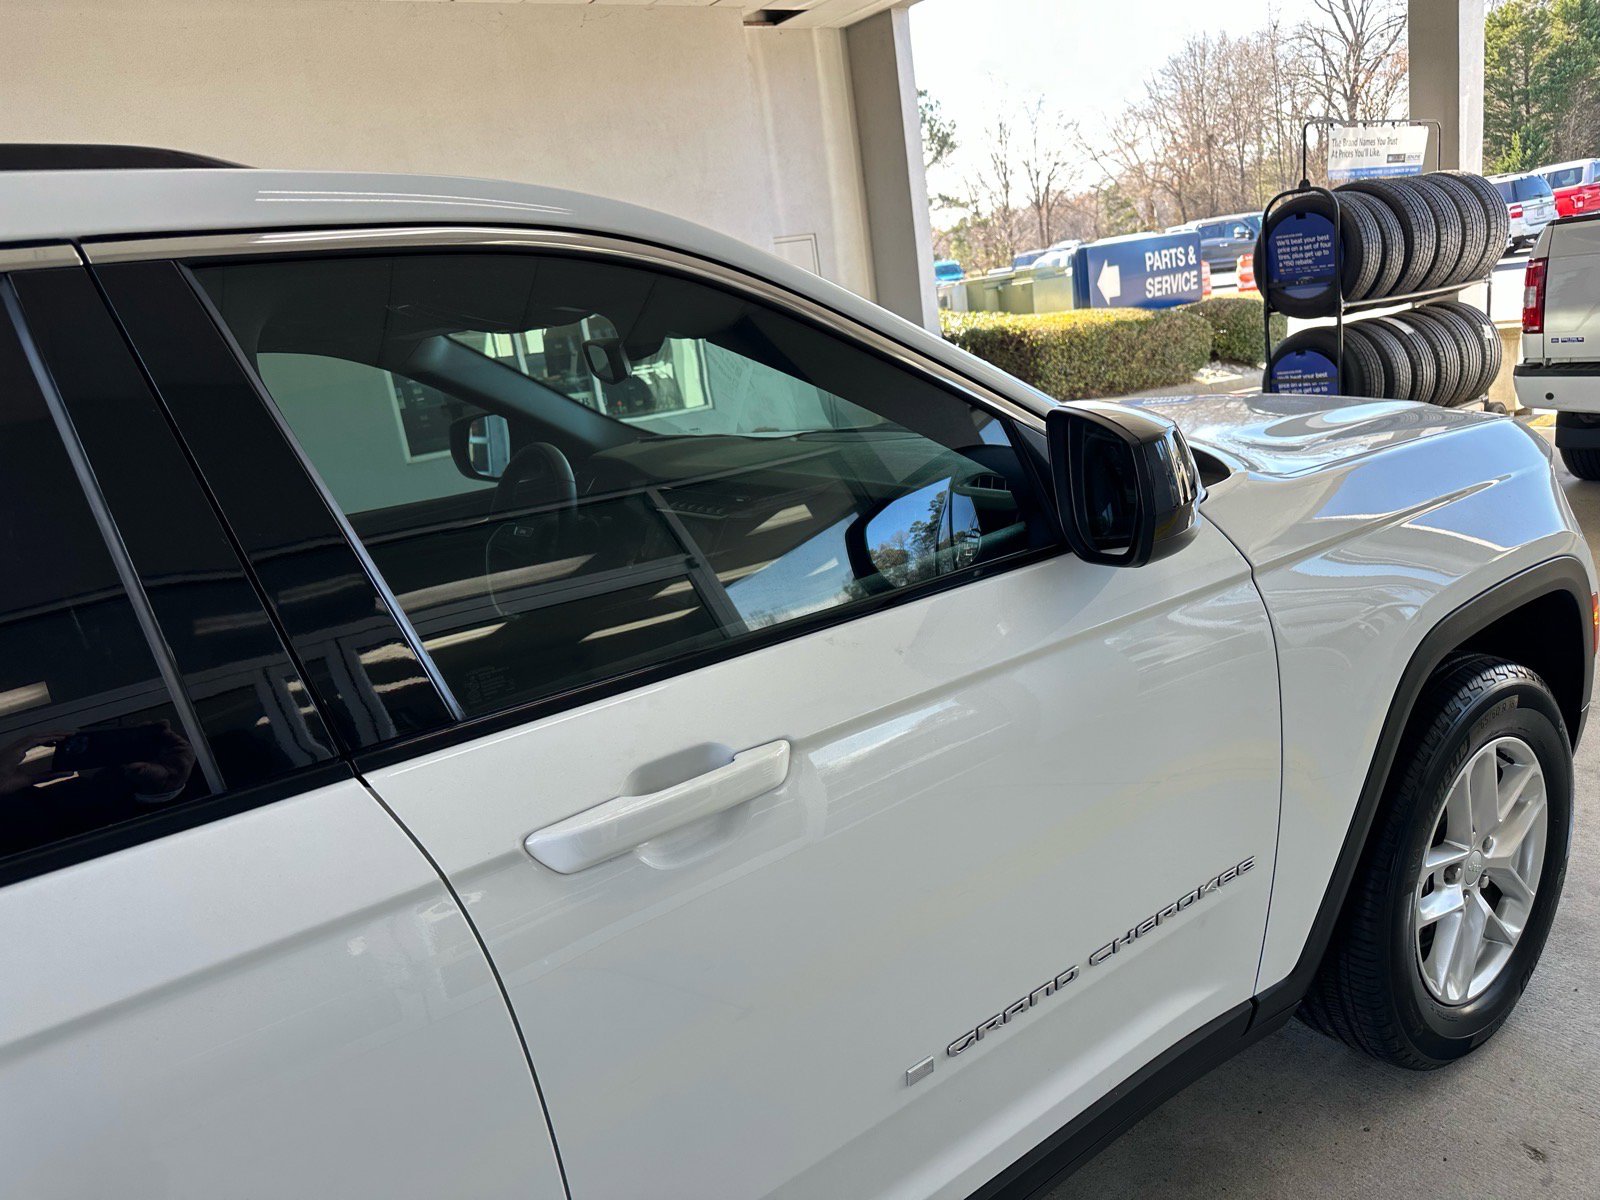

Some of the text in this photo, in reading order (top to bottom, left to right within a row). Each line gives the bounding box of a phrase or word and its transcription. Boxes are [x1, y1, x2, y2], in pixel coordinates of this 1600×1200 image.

[1331, 150, 1338, 158] At
[1338, 150, 1353, 158] Prices
[1354, 148, 1368, 158] You'll
[1332, 136, 1398, 148] The Brand Names You Trust
[1145, 245, 1196, 272] PARTS &
[1145, 270, 1198, 298] SERVICE
[947, 855, 1256, 1057] GRAND CHEROKEE
